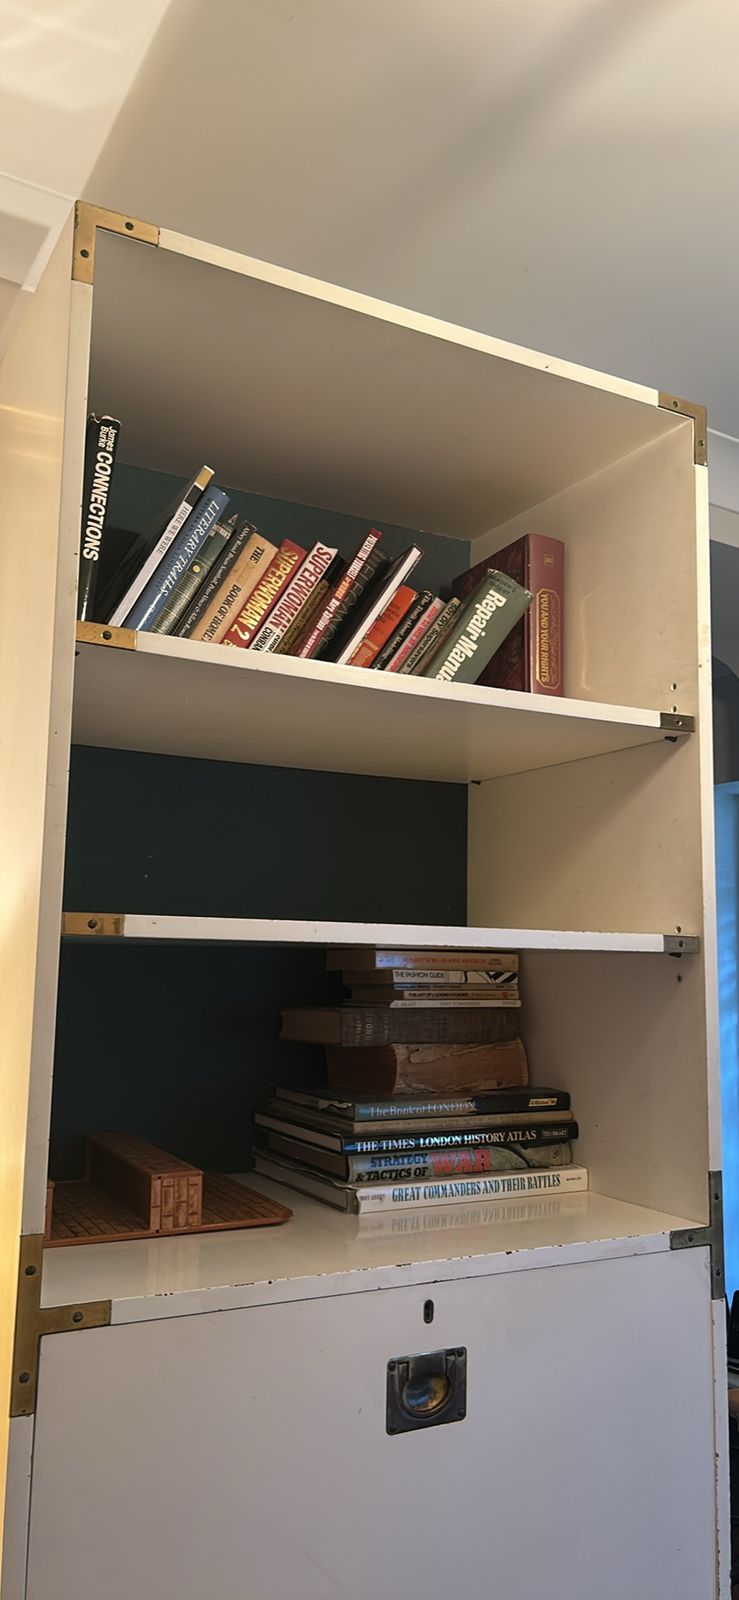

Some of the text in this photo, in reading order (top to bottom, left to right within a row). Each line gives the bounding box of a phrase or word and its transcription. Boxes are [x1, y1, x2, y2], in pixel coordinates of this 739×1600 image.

[98, 426, 109, 448] Burke
[105, 426, 117, 452] James
[83, 451, 113, 562] CONNECTIONS
[156, 505, 189, 555] HERE WE WERE
[183, 500, 220, 557] LITERARY
[237, 524, 250, 541] Abbey
[229, 538, 242, 554] Road
[159, 554, 188, 596] TRAILS
[237, 550, 299, 630] SUPERWOMAN
[268, 545, 333, 633] SUPERWOMAN
[202, 545, 265, 641] THE BOOK OF HOME
[325, 597, 340, 613] Mary
[468, 588, 507, 641] Repair
[231, 624, 250, 640] 2
[405, 602, 458, 668] 501 DIY Supersavers
[541, 593, 549, 683] YOU AND YOUR RIGHTS
[369, 1100, 477, 1117] The Book of LONDON
[355, 1129, 537, 1152] THE TIMES LONDON HISTORY ATLAS
[355, 1167, 429, 1182] & TACTICS OF
[370, 1152, 428, 1168] STRATEGY
[430, 1148, 490, 1179] WAR
[392, 1186, 421, 1203] GREAT
[423, 1179, 481, 1200] COMMANDERS
[482, 1178, 500, 1194] AND
[501, 1175, 526, 1193] THEIR
[528, 1173, 561, 1191] BATTLES
